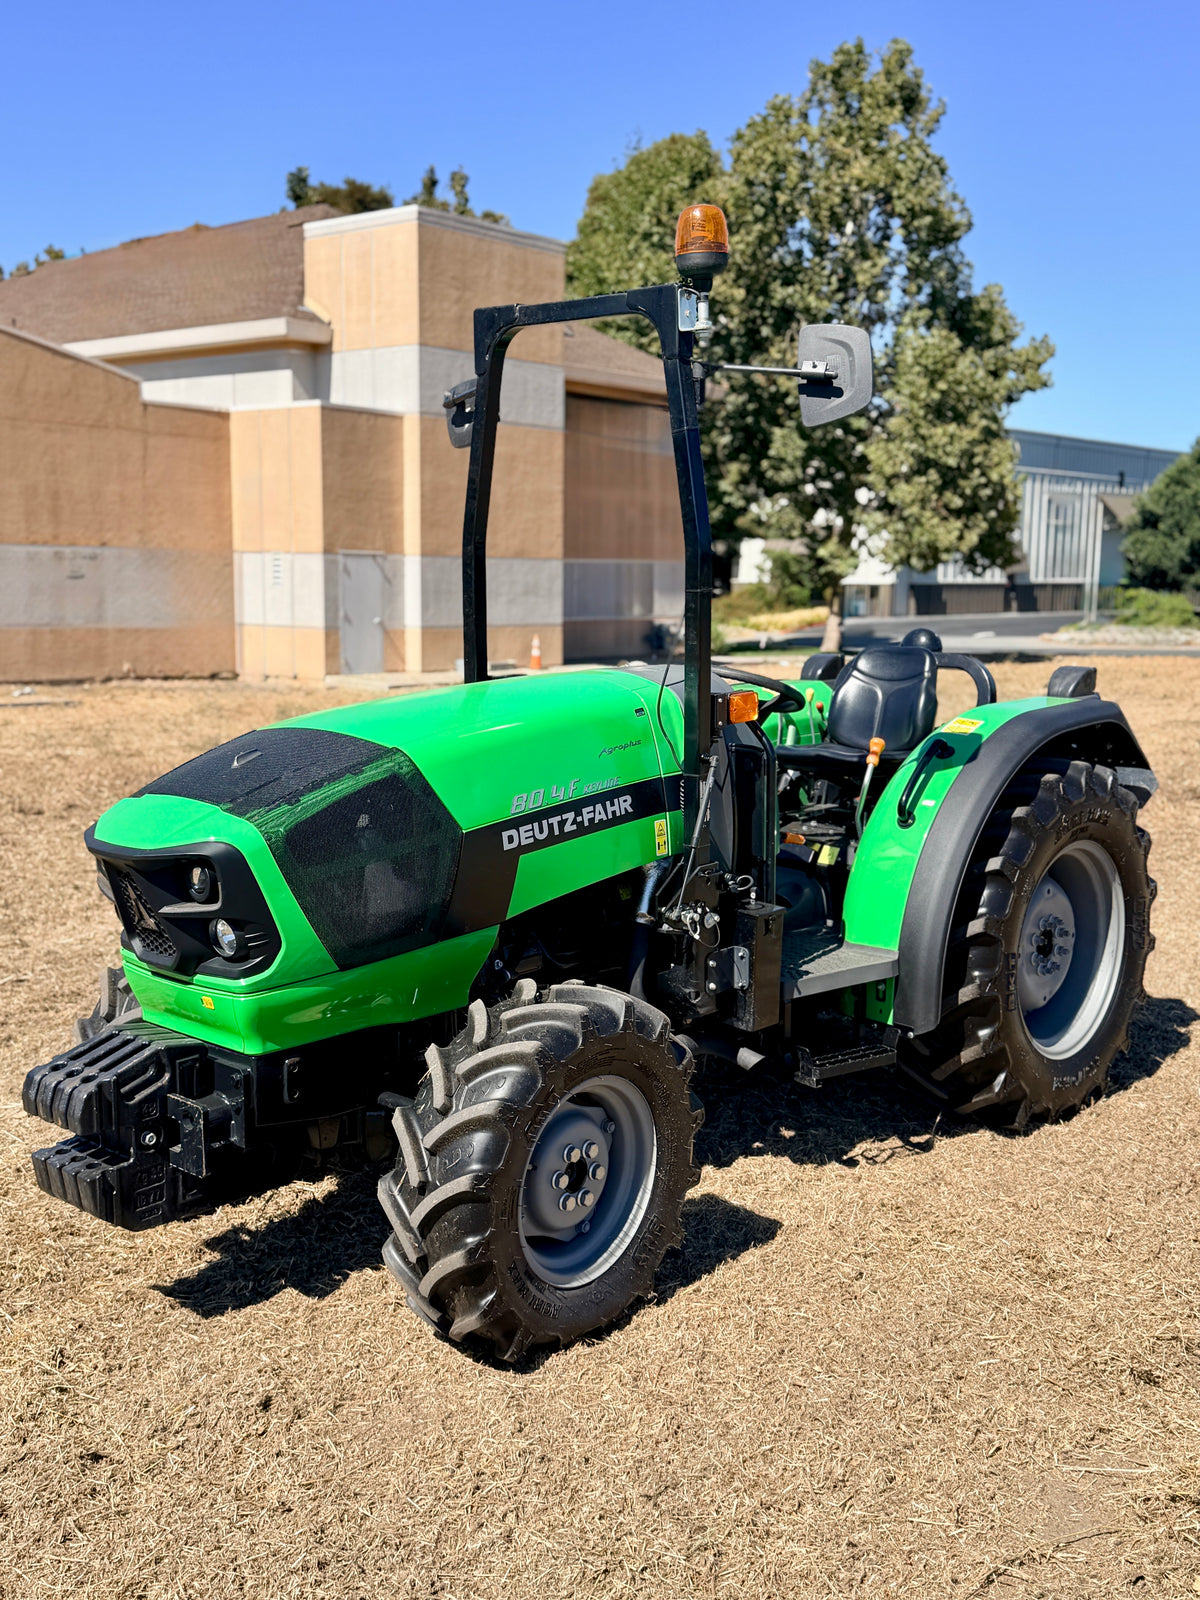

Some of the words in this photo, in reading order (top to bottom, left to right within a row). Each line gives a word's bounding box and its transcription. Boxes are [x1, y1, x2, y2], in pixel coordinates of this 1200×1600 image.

[598, 739, 642, 758] Agroplus
[583, 776, 621, 794] KEYLINE
[501, 794, 634, 851] DEUTZ-FAHR
[1006, 952, 1018, 1012] BKT
